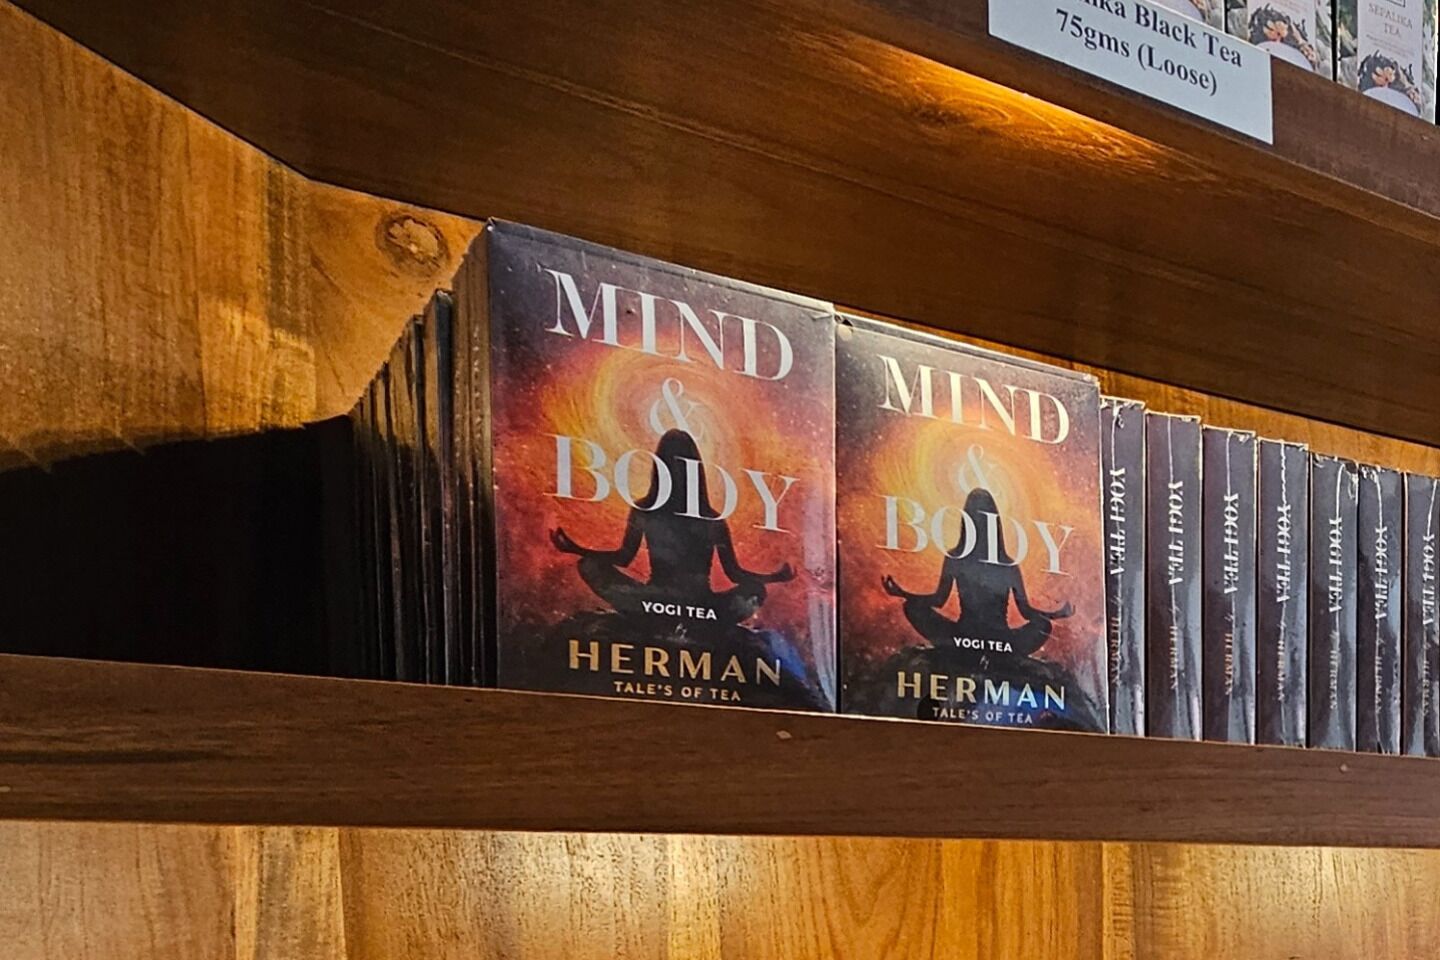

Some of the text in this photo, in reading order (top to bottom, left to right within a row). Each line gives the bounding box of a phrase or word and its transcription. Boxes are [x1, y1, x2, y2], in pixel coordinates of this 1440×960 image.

[1056, 9, 1217, 97] 75gms (Loose)
[1135, 0, 1197, 49] Black
[1202, 32, 1242, 67] Tea
[544, 268, 793, 381] MIND
[877, 354, 1070, 445] MIND
[537, 432, 800, 537] BODY
[1110, 467, 1126, 575] YOGI TEA
[875, 495, 1075, 579] BODY
[1168, 481, 1184, 585] YOGI TEA
[1224, 493, 1239, 594] YOGI TEA
[1277, 504, 1291, 602] YOGI TEA
[1328, 517, 1343, 613] YOGI TEA
[1375, 526, 1388, 620] YOGI TEA
[642, 600, 718, 620] YOGI TEA
[1422, 534, 1435, 626] YOGI TEA
[568, 639, 781, 686] HERMAN
[897, 671, 1065, 710] HERMAN
[954, 637, 1013, 653] YOGI TEA
[614, 681, 741, 701] TALE'S OF TEA
[932, 707, 1033, 724] TALE'S OF TEA
